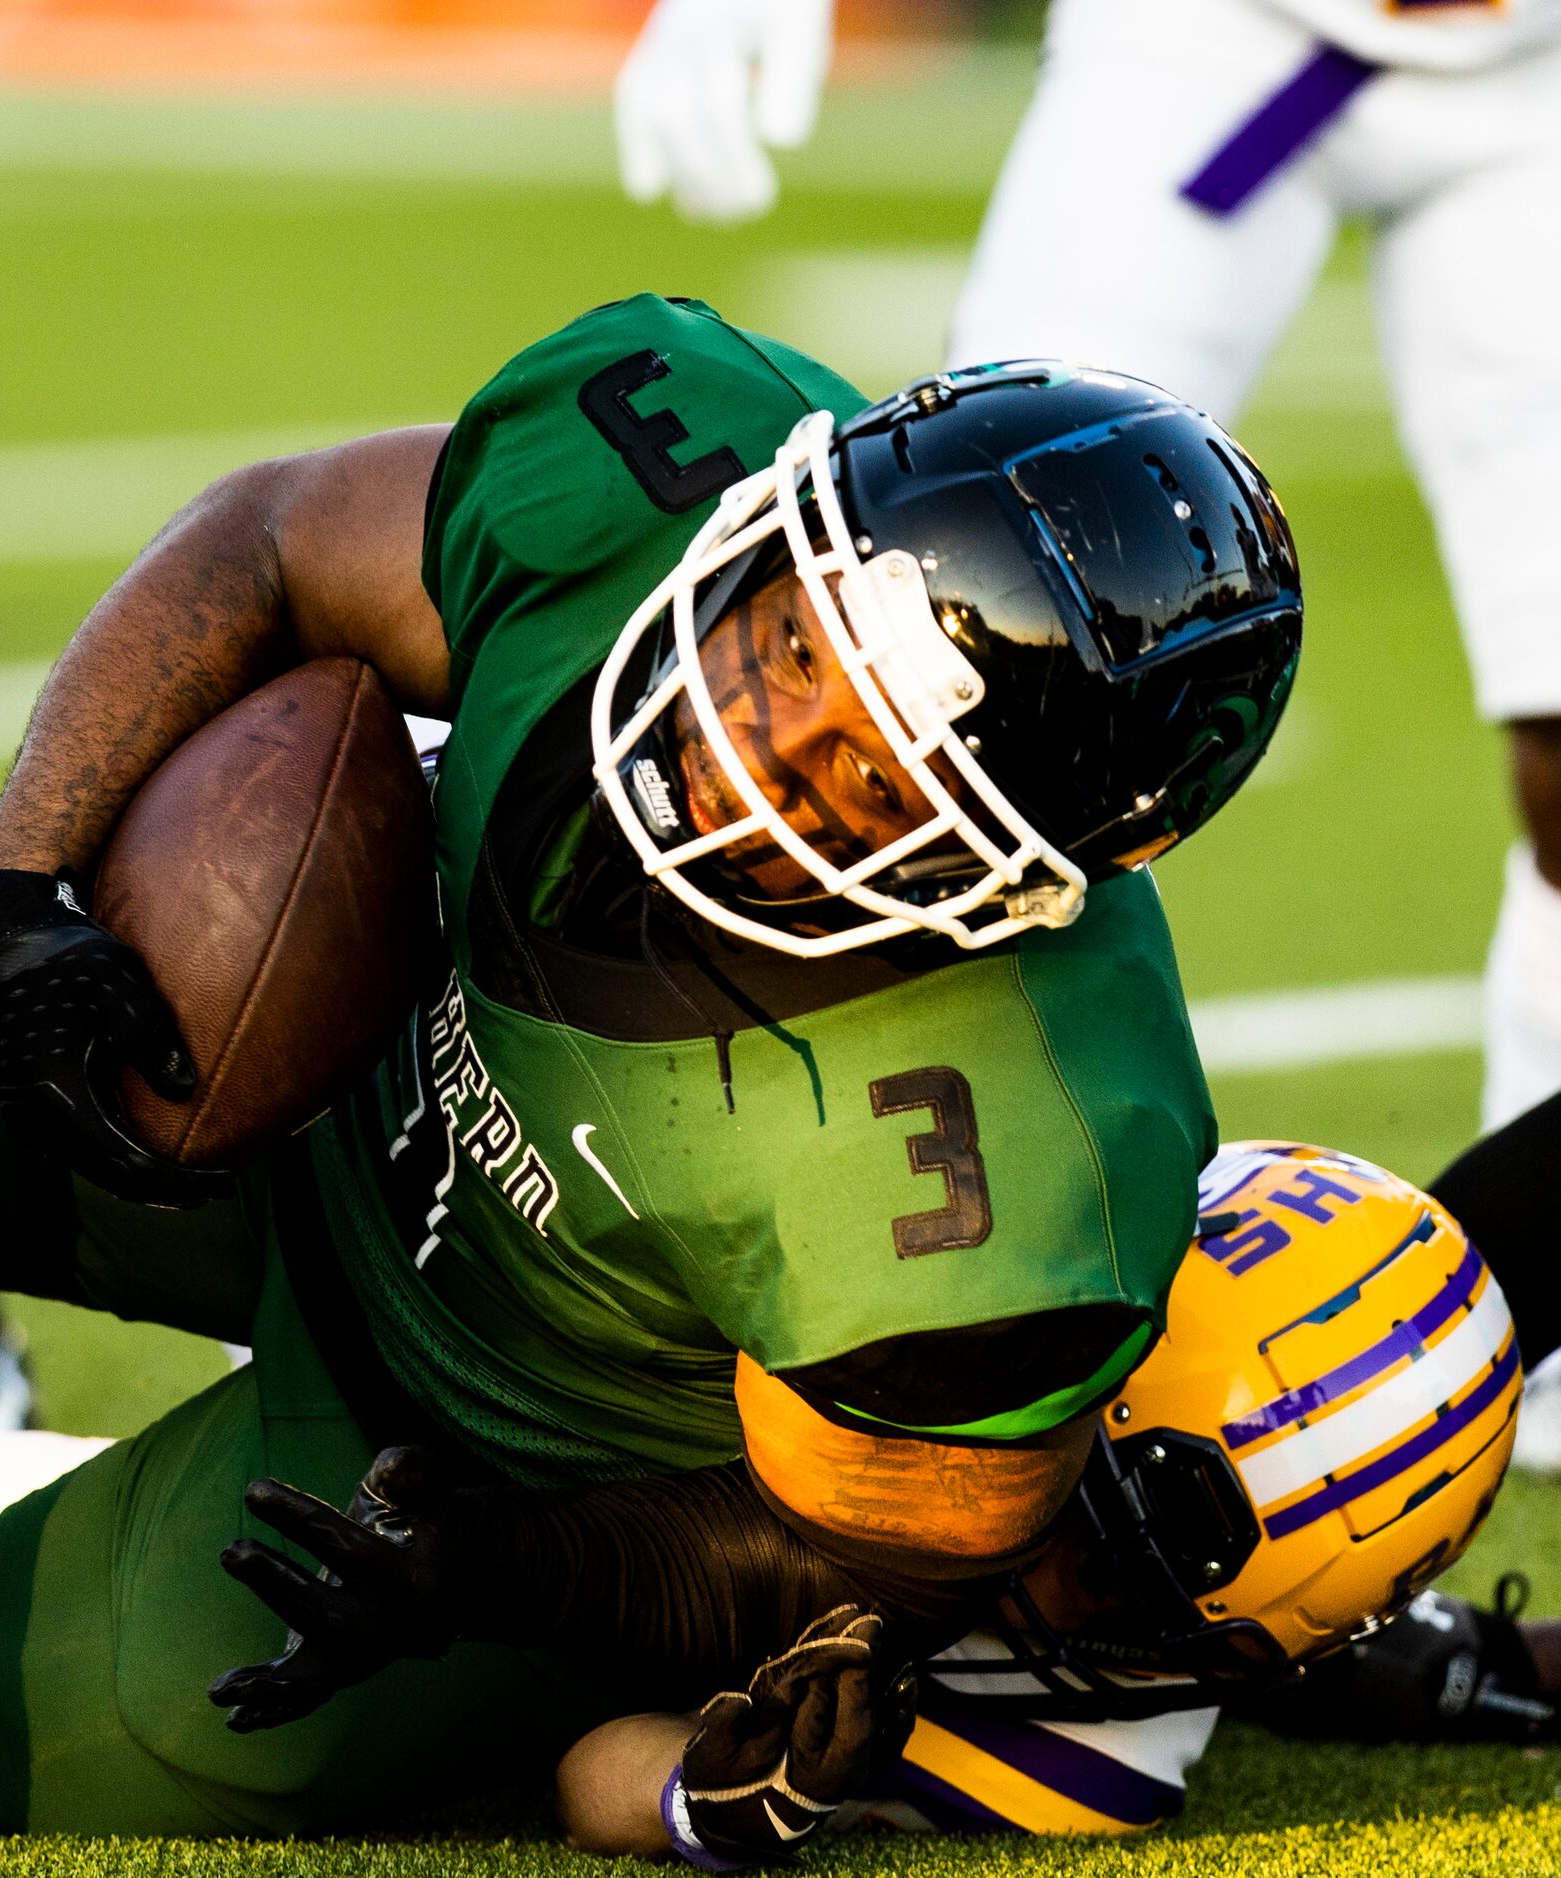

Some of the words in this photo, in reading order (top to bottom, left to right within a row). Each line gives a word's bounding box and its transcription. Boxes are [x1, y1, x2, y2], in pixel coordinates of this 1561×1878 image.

[577, 348, 750, 515] 3
[868, 1065, 993, 1260] 3
[1198, 1160, 1376, 1278] HS
